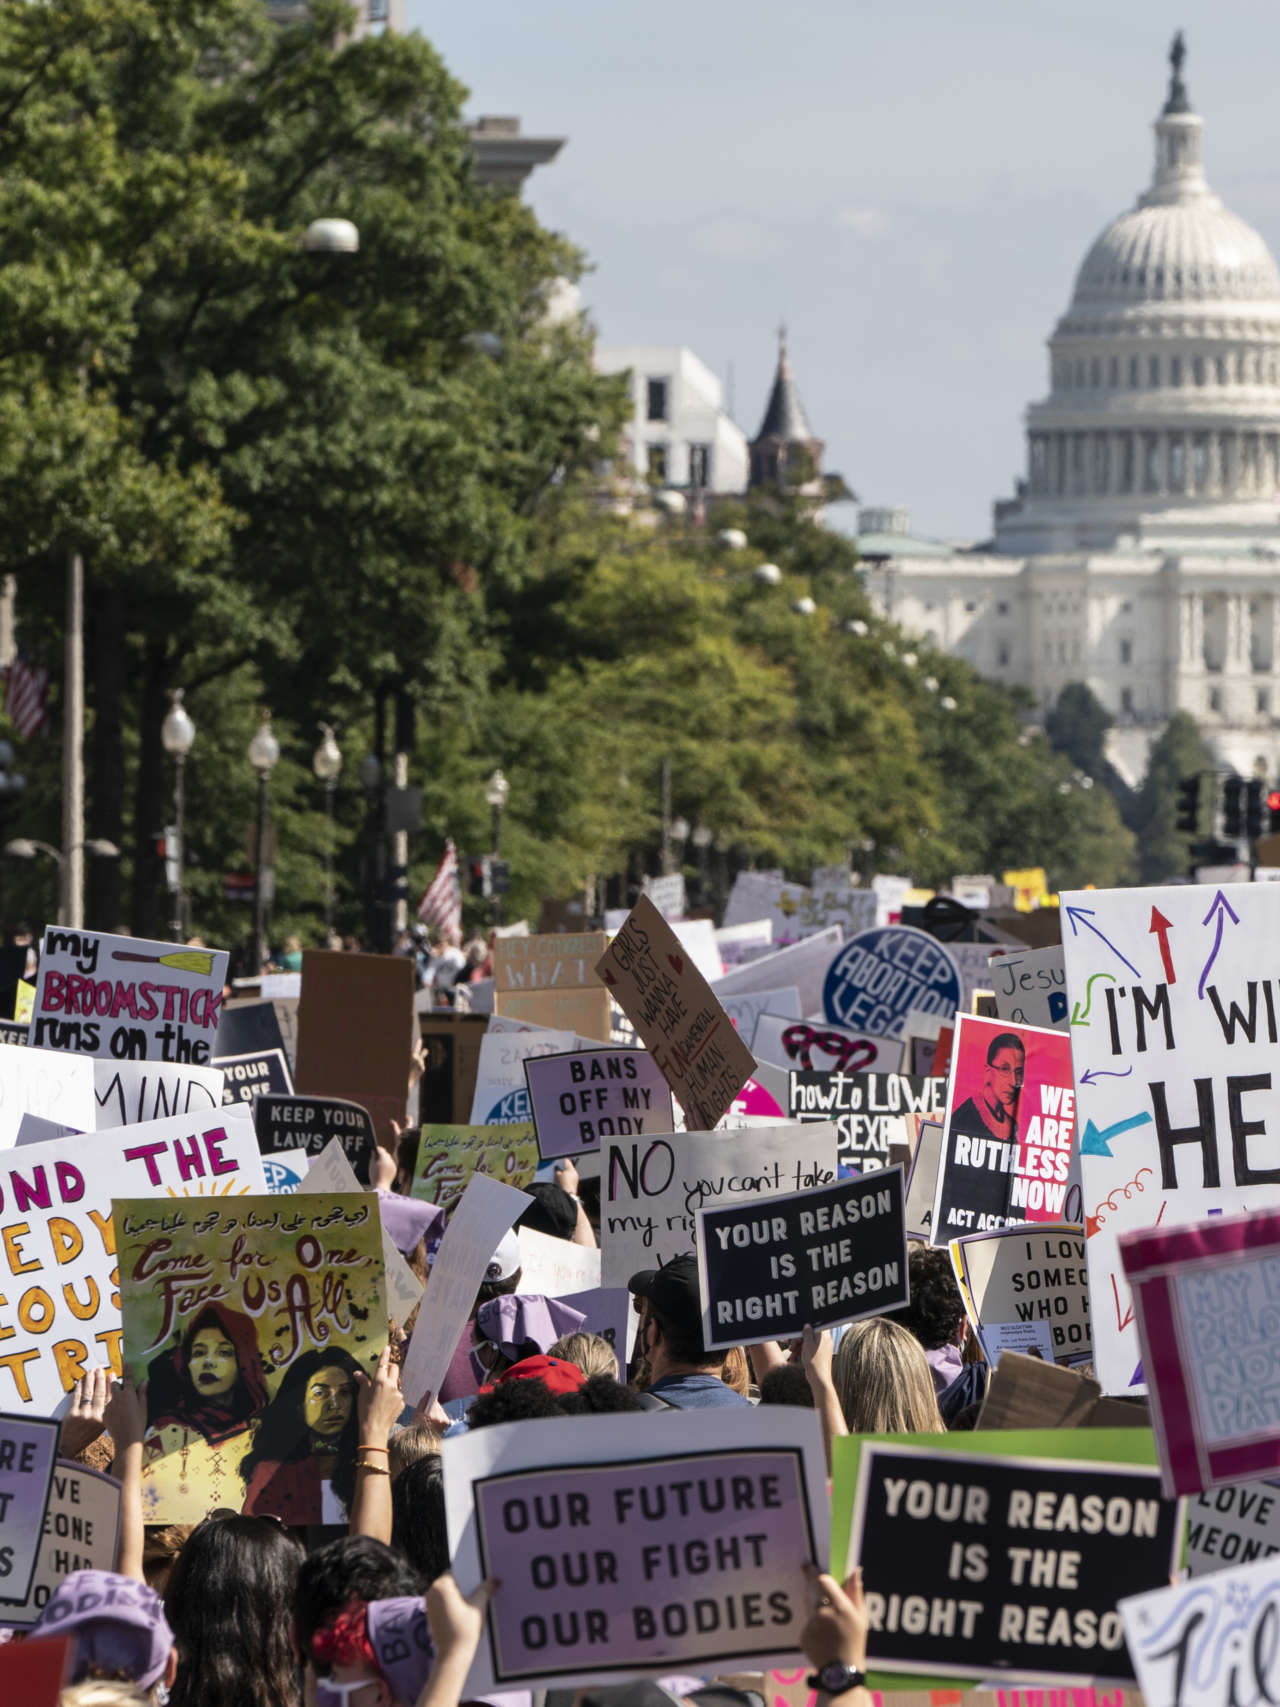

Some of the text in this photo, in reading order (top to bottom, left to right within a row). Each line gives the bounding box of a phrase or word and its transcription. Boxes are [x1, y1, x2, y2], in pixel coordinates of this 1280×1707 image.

[46, 931, 99, 974] my
[612, 918, 649, 971] GIRLS
[874, 932, 952, 985] KEEP
[632, 951, 660, 994] JUST
[834, 945, 956, 1020] ABORTION
[41, 970, 223, 1029] BROOMSTICK
[638, 973, 678, 1028] WANNA
[658, 992, 688, 1039] HAVE
[1105, 983, 1176, 1056] I'M
[34, 1016, 210, 1065] runs on the
[223, 1061, 269, 1082] YOUR
[569, 1056, 638, 1083] BANS
[685, 1043, 725, 1098] HUMAN
[791, 1071, 838, 1111] how
[829, 1072, 862, 1110] to
[868, 1073, 949, 1113] LOWE
[271, 1105, 365, 1129] KEEP YOUR
[559, 1087, 651, 1116] OFF MY
[700, 1065, 741, 1126] RIGHTS
[1040, 1084, 1075, 1118] WE
[273, 1131, 323, 1149] LAWS
[578, 1117, 644, 1145] BODY
[1025, 1115, 1073, 1151] ARE
[123, 1127, 239, 1187] THE
[422, 1152, 466, 1179] Come
[608, 1140, 675, 1201] NO
[683, 1175, 724, 1214] you
[954, 1135, 1070, 1181] RUTHLESS
[947, 1207, 975, 1228] ACT
[1011, 1177, 1067, 1214] NOW
[608, 1215, 658, 1247] my
[715, 1189, 892, 1250] YOUR REASON
[128, 1238, 210, 1282] Come
[223, 1234, 275, 1280] for
[770, 1239, 852, 1279] IS THE
[1026, 1242, 1032, 1260] I
[717, 1261, 899, 1325] RIGHT REASON
[1015, 1296, 1068, 1322] WHO
[1182, 1269, 1252, 1315] MY
[140, 1270, 350, 1366] Face Us All
[502, 1474, 783, 1534] OUR FUTURE
[883, 1477, 1160, 1539] YOUR REASON
[1198, 1486, 1275, 1526] LOVE
[531, 1533, 769, 1590] OUR FIGHT
[949, 1541, 1082, 1590] IS THE
[521, 1591, 793, 1651] OUR BODIES
[866, 1592, 983, 1640] RIGHT
